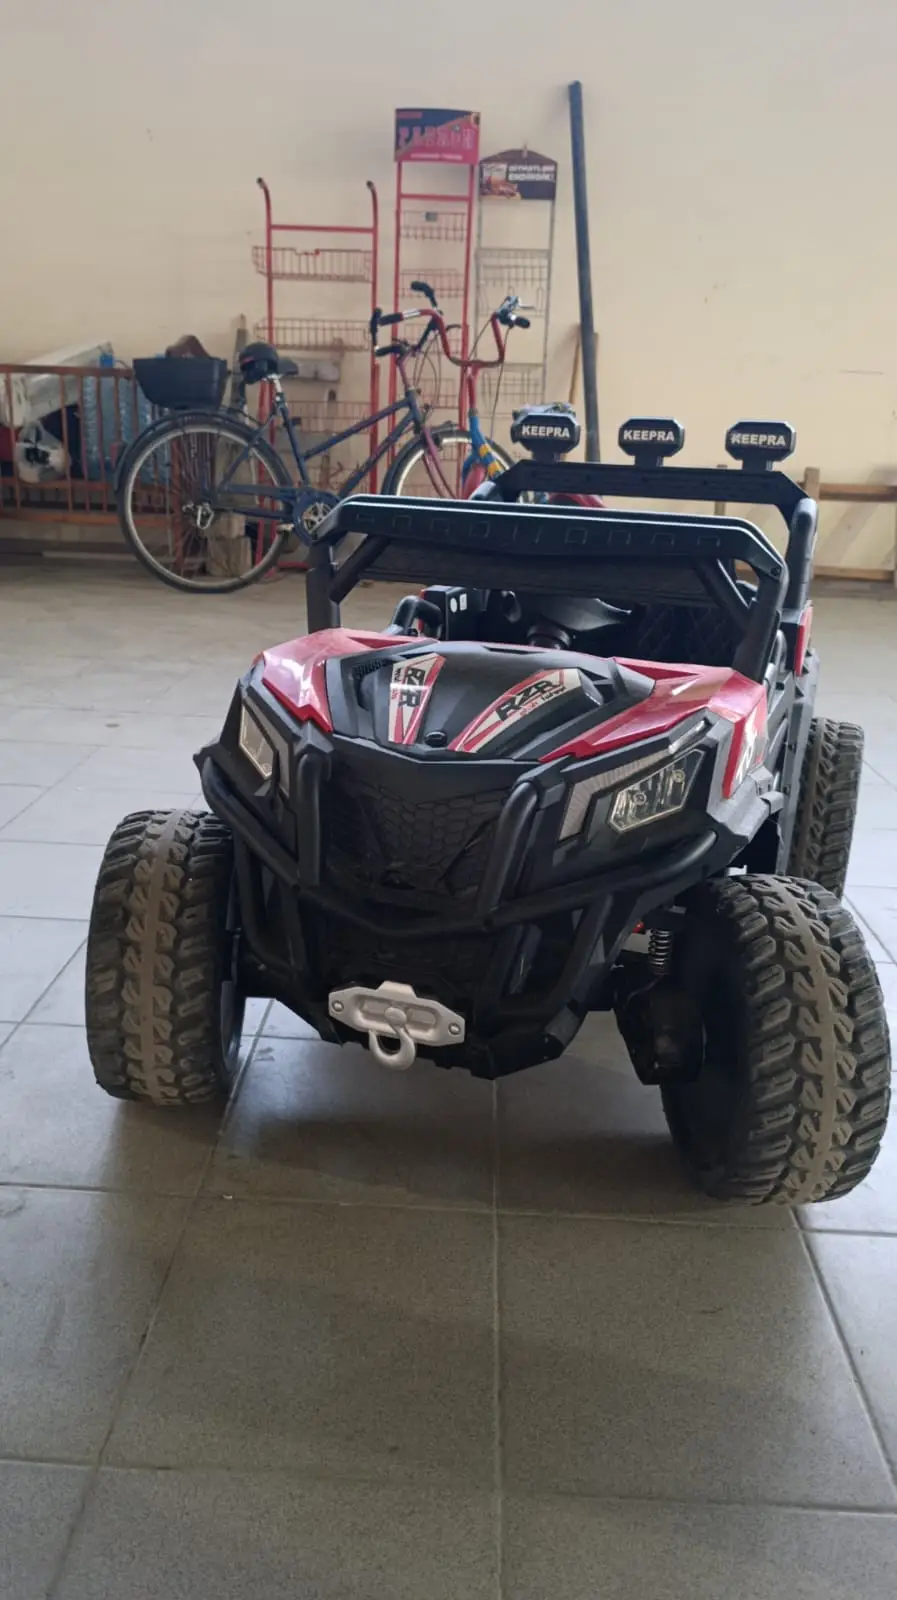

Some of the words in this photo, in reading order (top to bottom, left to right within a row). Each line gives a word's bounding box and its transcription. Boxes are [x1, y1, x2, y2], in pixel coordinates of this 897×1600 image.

[521, 424, 570, 438] KEEPRA
[623, 430, 675, 442] KEEPRA
[731, 433, 786, 446] KEEPRA
[399, 667, 427, 708] RZR
[496, 680, 561, 721] RZR
